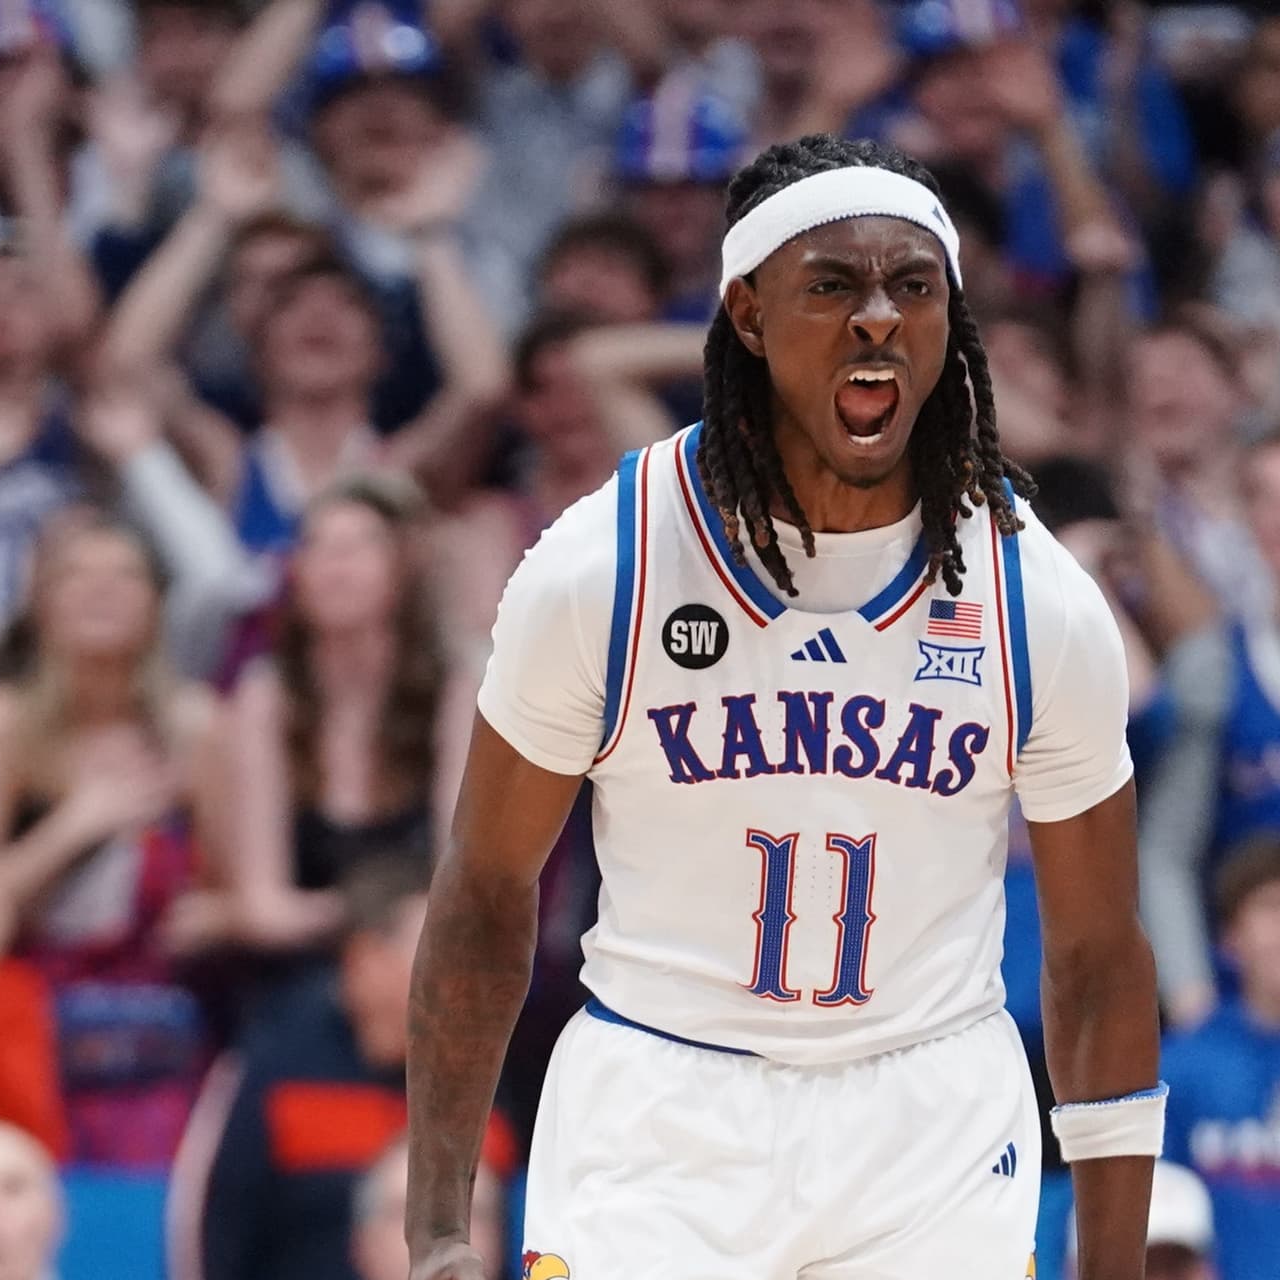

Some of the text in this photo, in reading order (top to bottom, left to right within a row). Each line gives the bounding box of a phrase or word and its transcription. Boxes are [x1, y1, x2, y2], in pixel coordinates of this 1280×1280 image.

[669, 619, 720, 656] SW
[915, 641, 984, 685] XII
[647, 690, 990, 797] KANSAS
[736, 828, 878, 1008] 11
